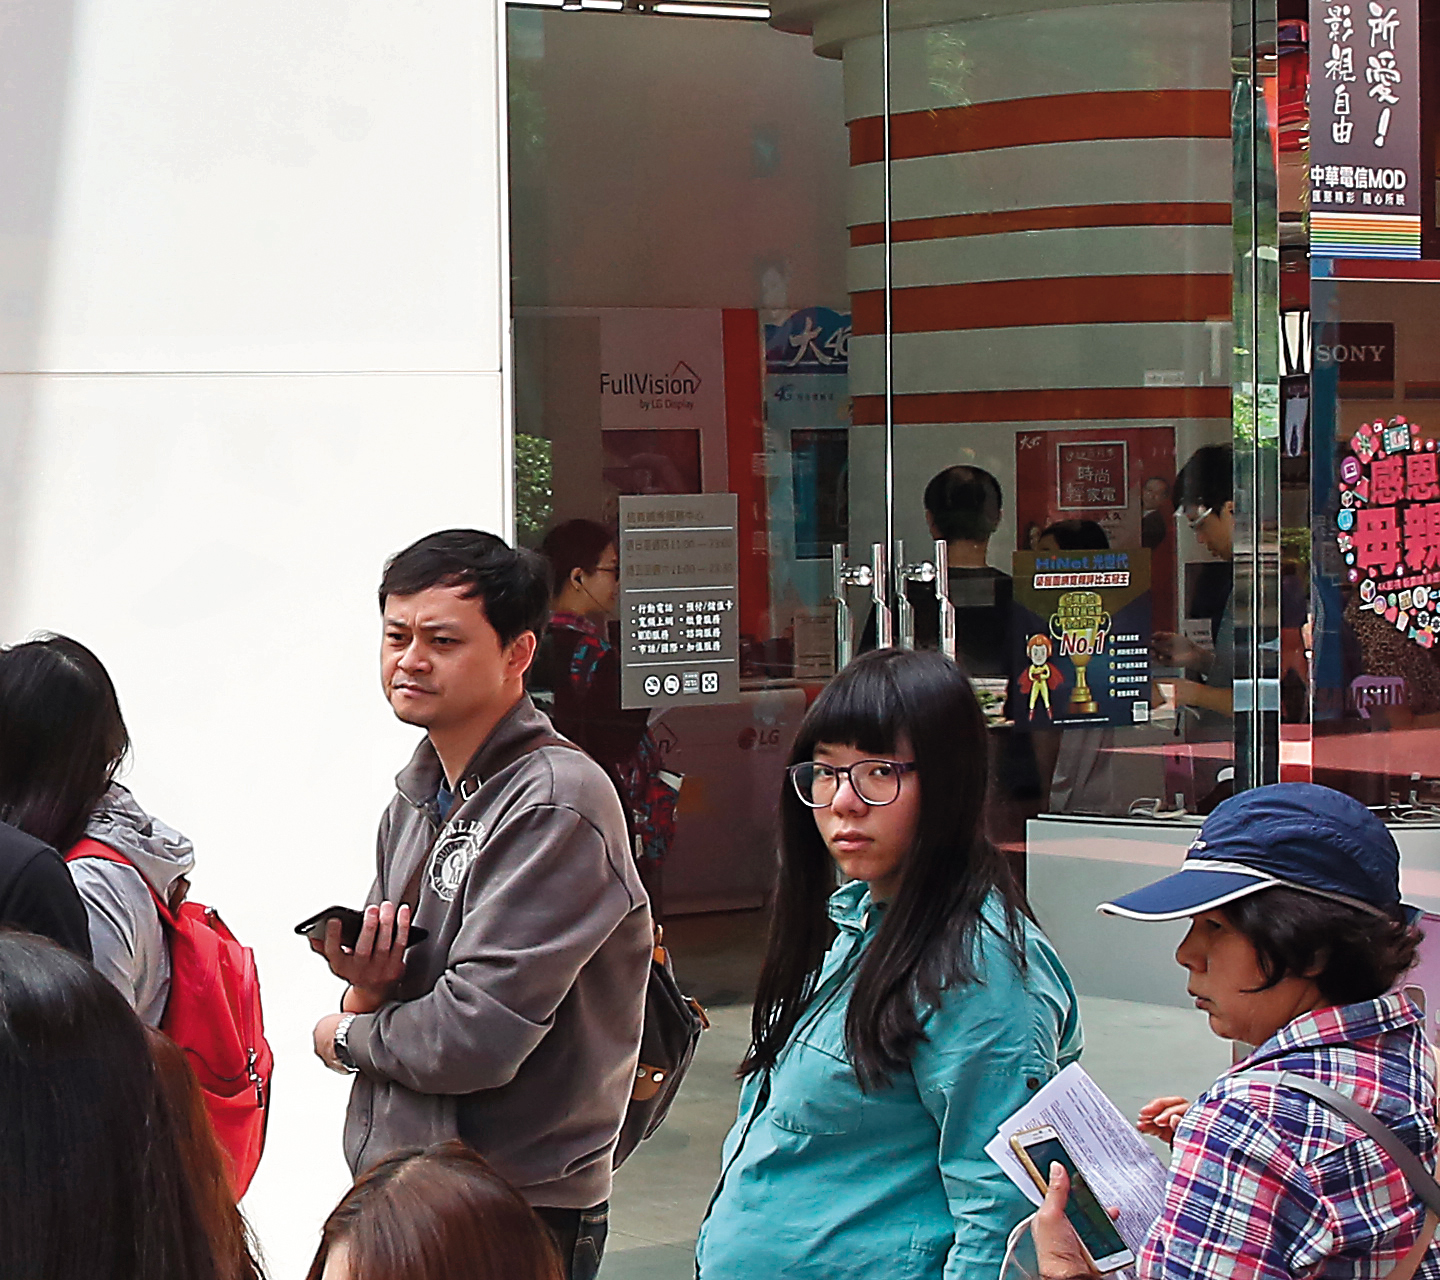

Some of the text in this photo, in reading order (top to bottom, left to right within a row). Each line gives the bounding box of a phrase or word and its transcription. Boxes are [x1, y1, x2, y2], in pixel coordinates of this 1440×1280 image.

[1310, 165, 1406, 190] 中華電信MOD
[1315, 344, 1386, 363] SONY
[600, 372, 696, 396] FullVision
[640, 398, 694, 411] by LG Display
[1370, 452, 1440, 505] 感恩
[1061, 630, 1105, 655] No.1
[760, 729, 780, 745] LG
